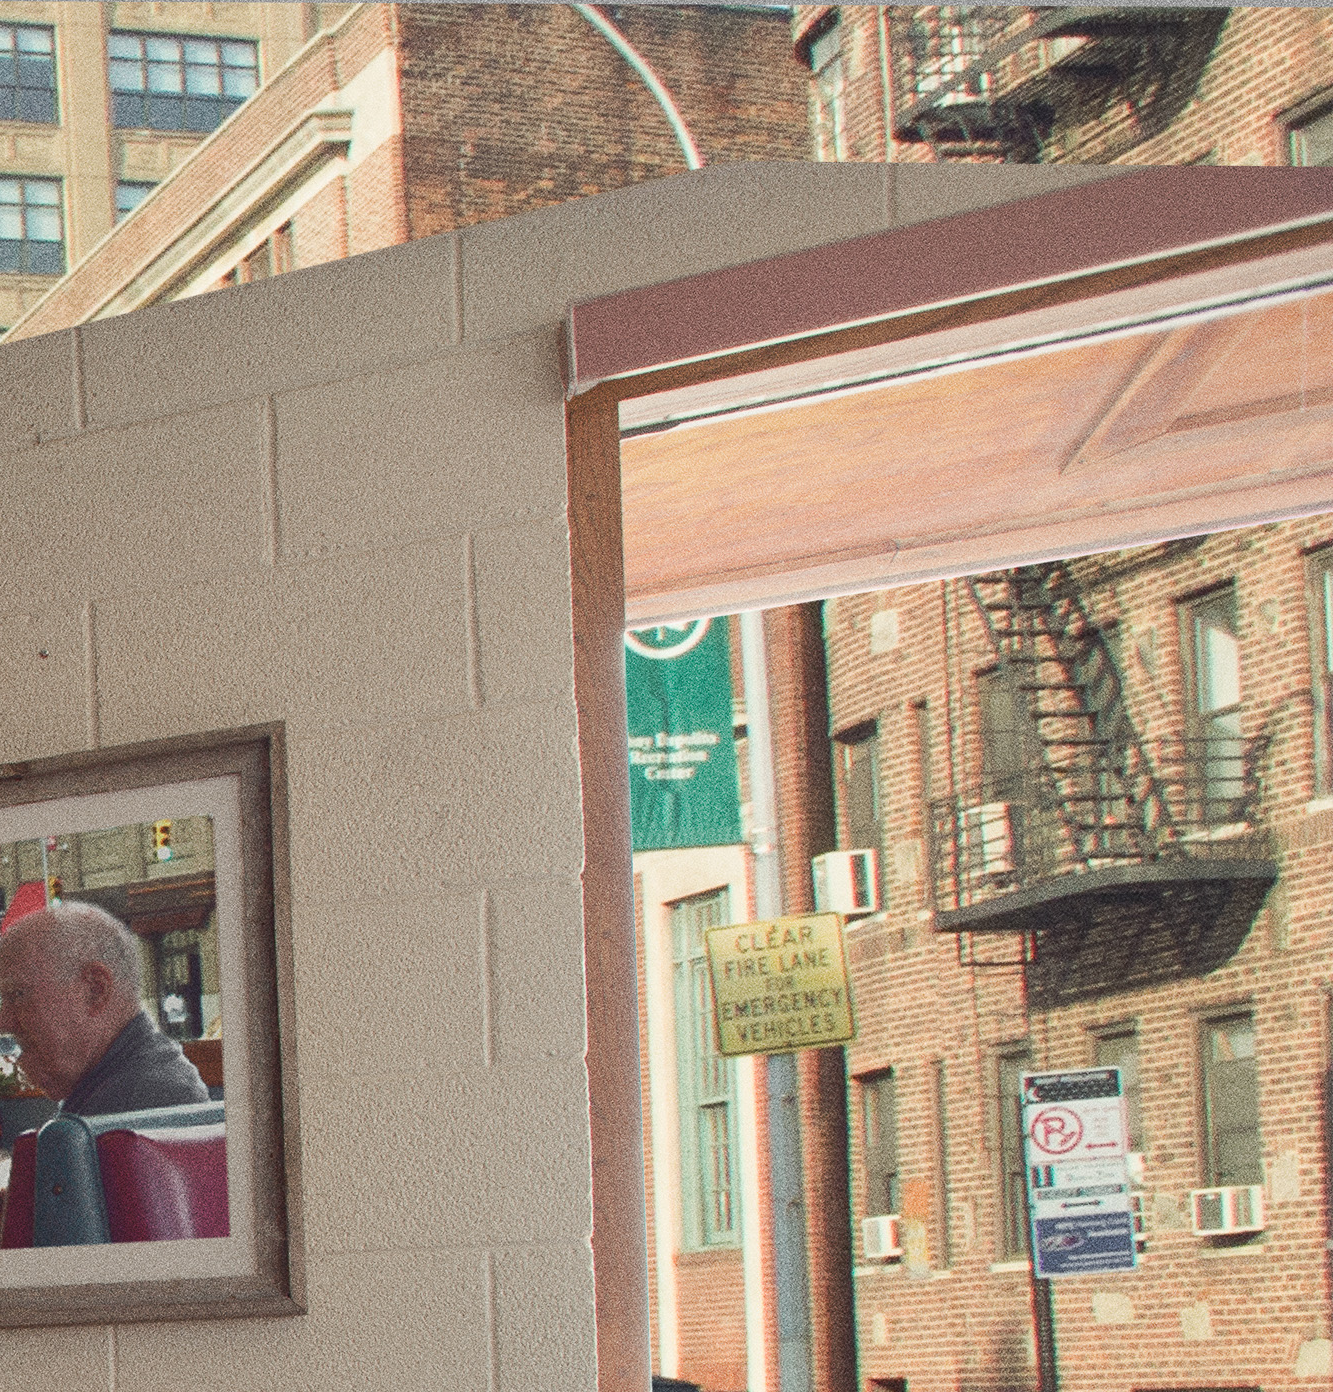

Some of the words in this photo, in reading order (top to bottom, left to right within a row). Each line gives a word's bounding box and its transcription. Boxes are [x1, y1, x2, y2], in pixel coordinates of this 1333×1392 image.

[629, 749, 709, 764] Recreation
[644, 766, 696, 780] Center
[735, 925, 813, 953] CLEAR
[724, 957, 770, 980] FIRE
[778, 948, 830, 973] LANE
[765, 975, 795, 993] FOR
[722, 988, 842, 1021] EMERGENCY
[737, 1013, 834, 1042] VEHICLES
